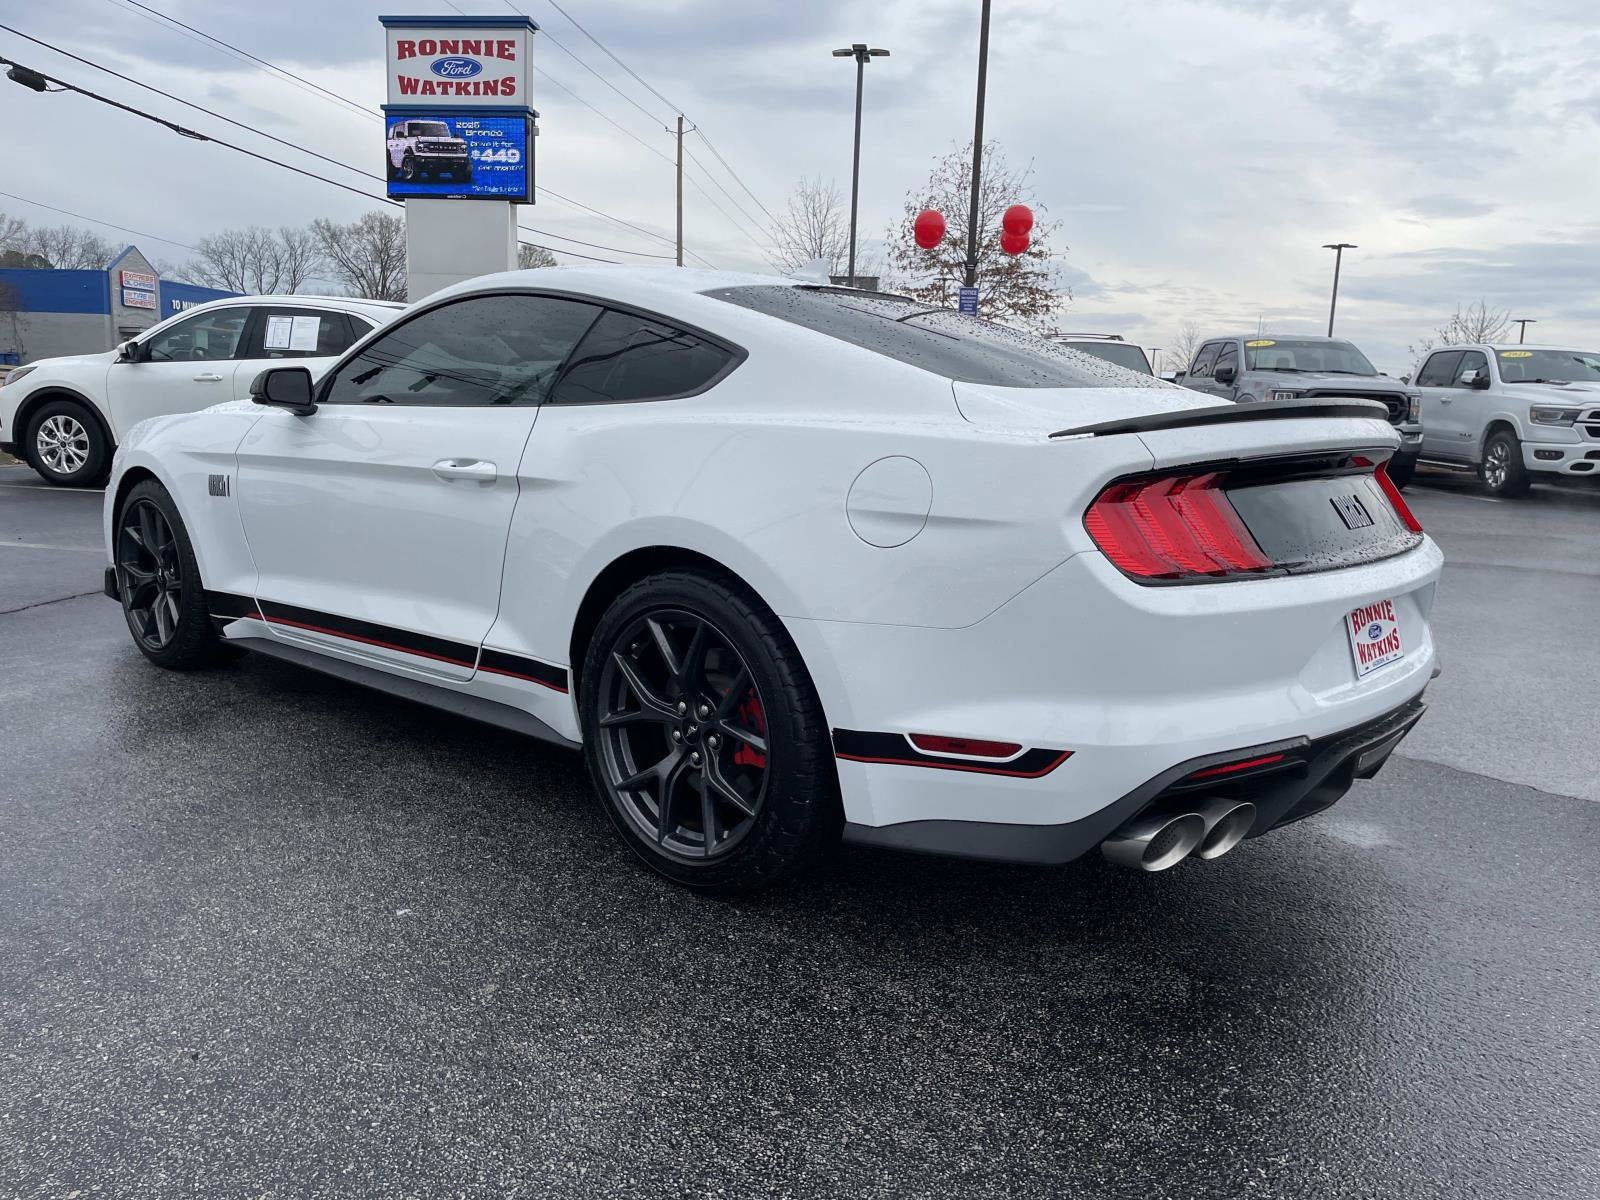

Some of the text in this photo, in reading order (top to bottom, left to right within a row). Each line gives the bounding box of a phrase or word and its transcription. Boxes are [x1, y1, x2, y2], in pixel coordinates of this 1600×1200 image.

[397, 39, 516, 61] RONNIE
[440, 60, 473, 75] Ford
[398, 75, 516, 96] WATKINS
[471, 149, 520, 163] $449
[123, 272, 154, 282] EXPRESS
[172, 300, 181, 310] 10
[1351, 600, 1395, 636] RONNIE
[1357, 628, 1400, 664] WATKINS
